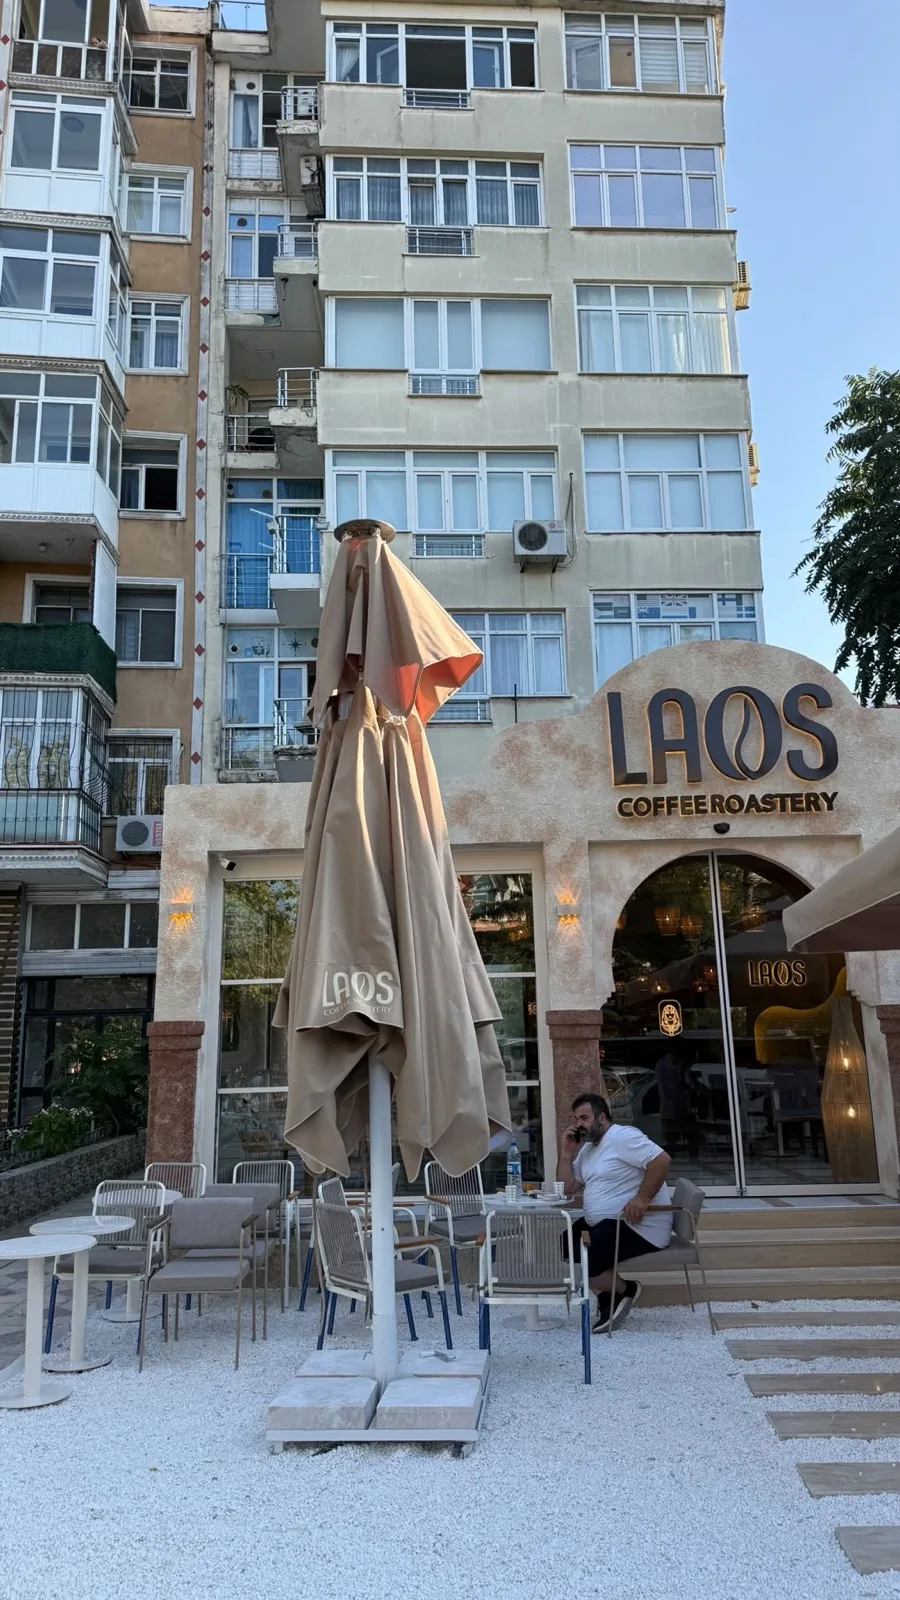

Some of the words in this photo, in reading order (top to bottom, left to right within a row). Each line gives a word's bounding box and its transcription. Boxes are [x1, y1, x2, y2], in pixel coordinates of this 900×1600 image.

[607, 683, 839, 786] LAOS
[617, 796, 706, 817] COFFEE
[710, 792, 839, 815] ROASTERY
[322, 971, 394, 1007] LAOS
[748, 960, 807, 987] LAOS
